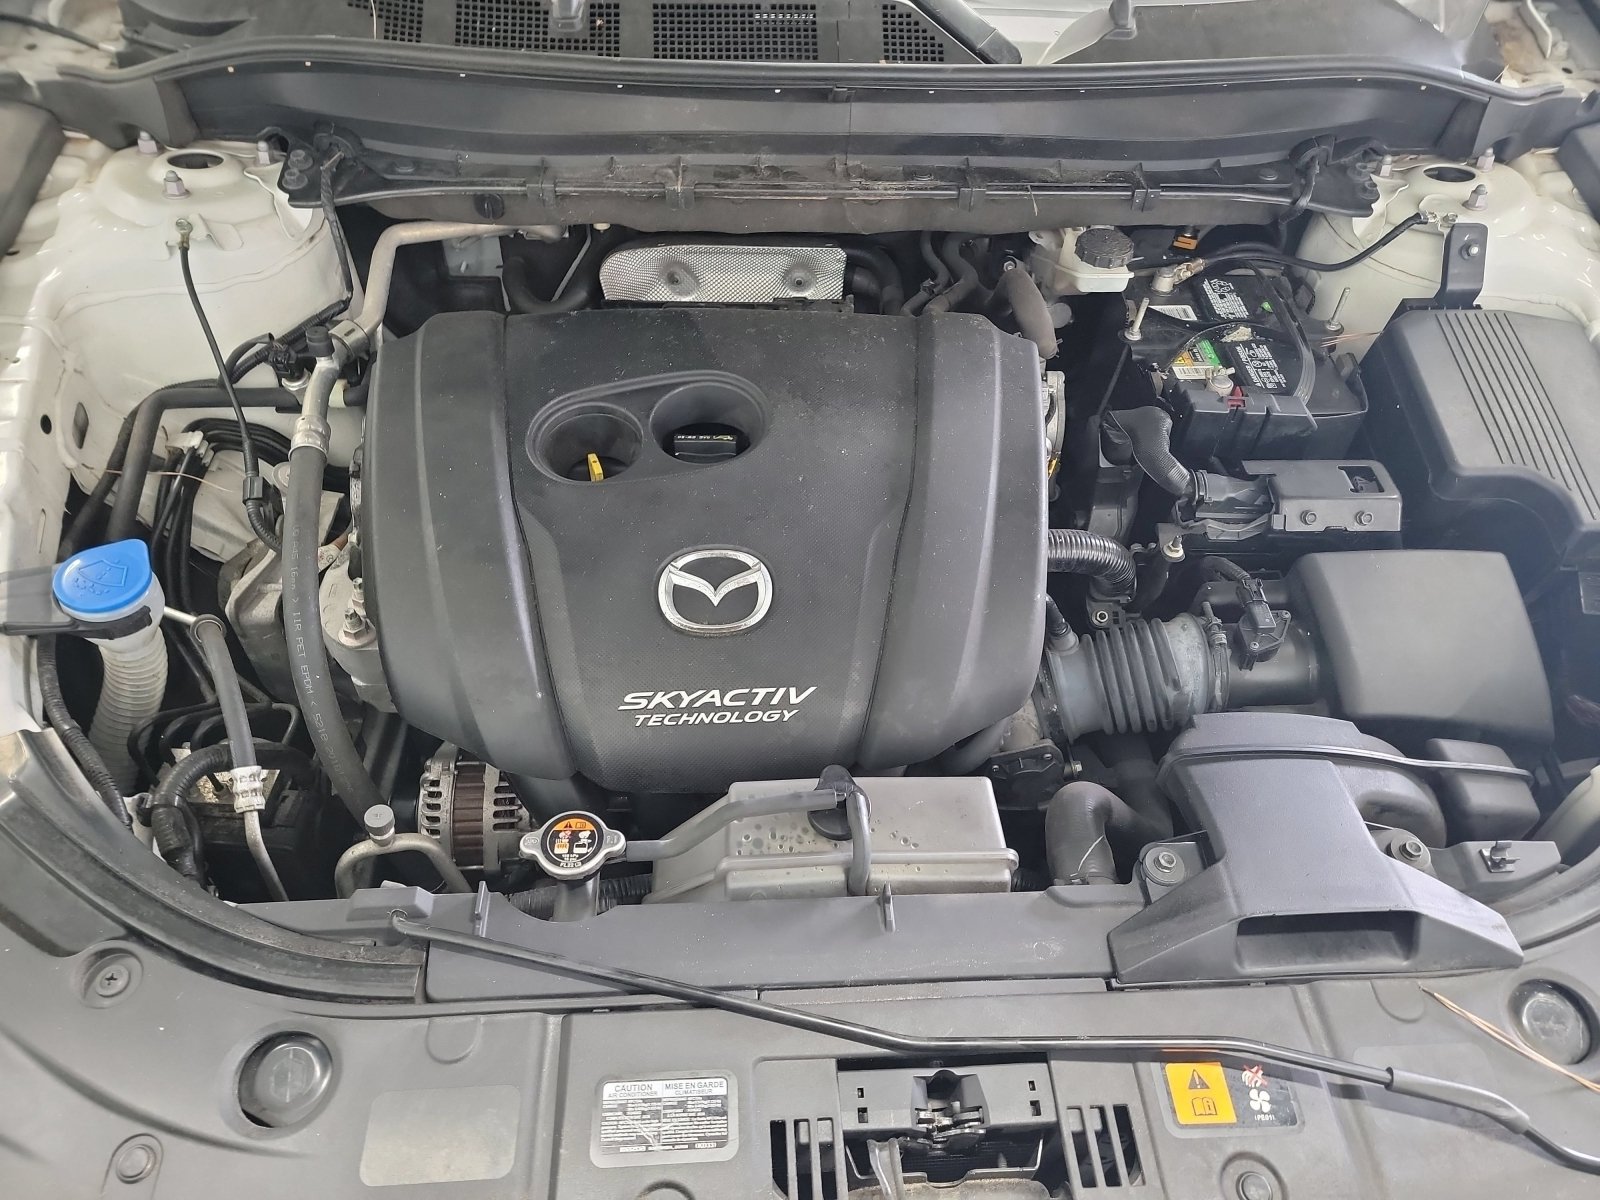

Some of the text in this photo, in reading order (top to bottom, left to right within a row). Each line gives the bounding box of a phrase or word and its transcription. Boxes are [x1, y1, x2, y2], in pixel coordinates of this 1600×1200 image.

[295, 636, 306, 657] PET
[617, 686, 818, 711] SKYACTIV
[634, 709, 799, 727] TECHNOLOGY
[614, 1083, 653, 1092] CAUTION
